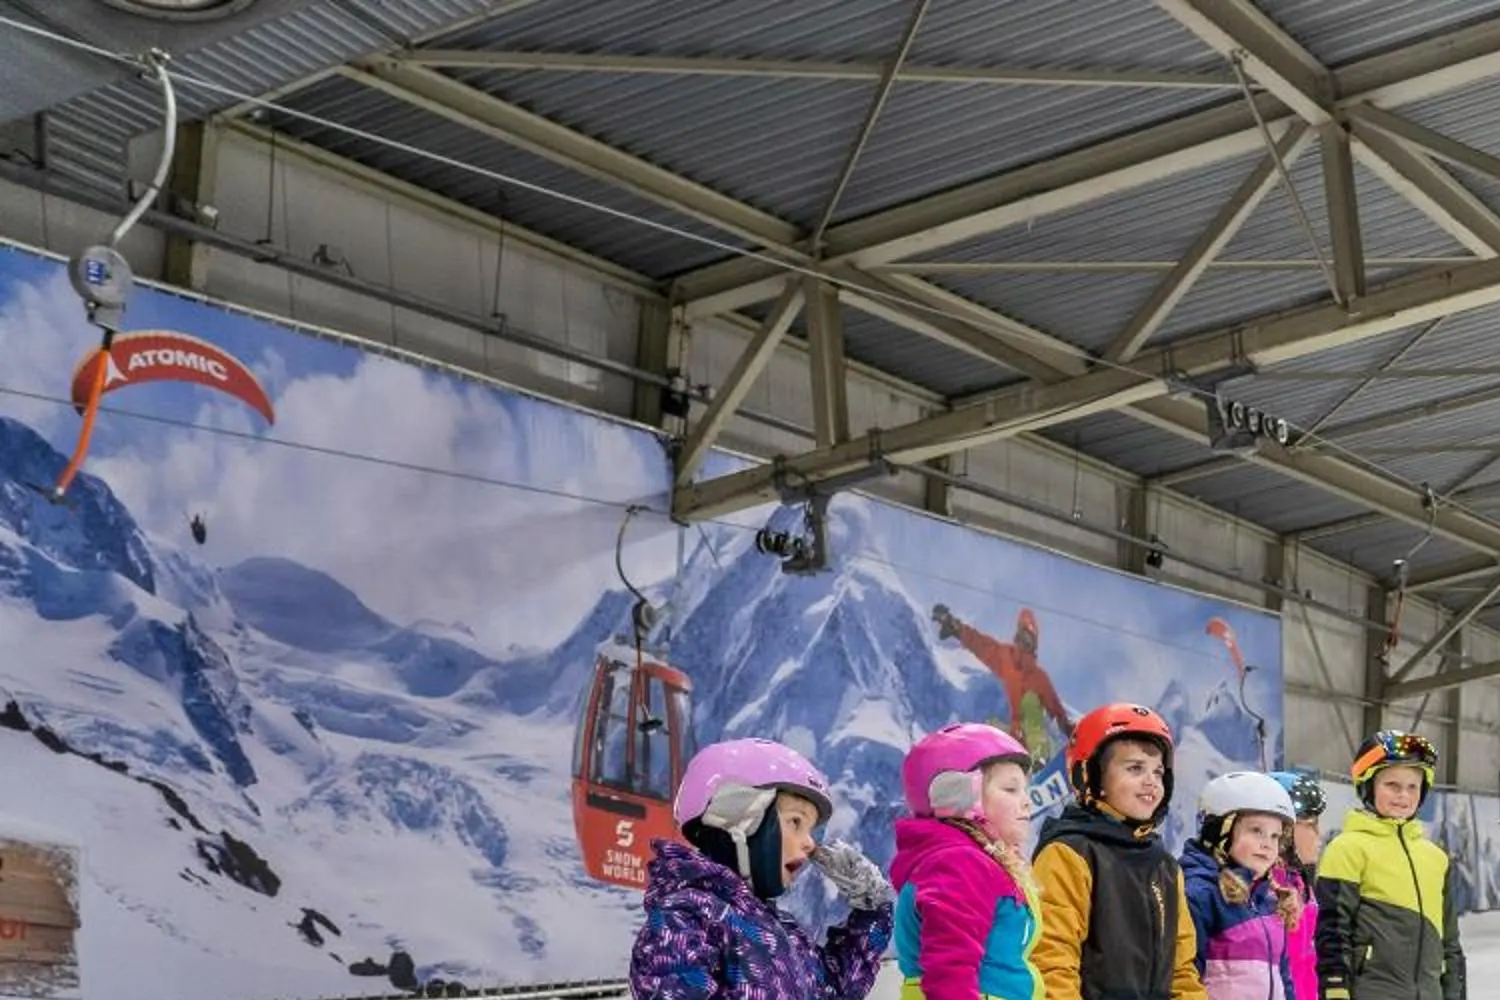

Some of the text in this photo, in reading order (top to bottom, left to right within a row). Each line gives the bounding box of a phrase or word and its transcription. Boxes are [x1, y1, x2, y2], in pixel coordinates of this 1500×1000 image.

[128, 349, 228, 381] ATOMIC
[606, 849, 643, 868] SNOW
[602, 863, 645, 883] WORLD
